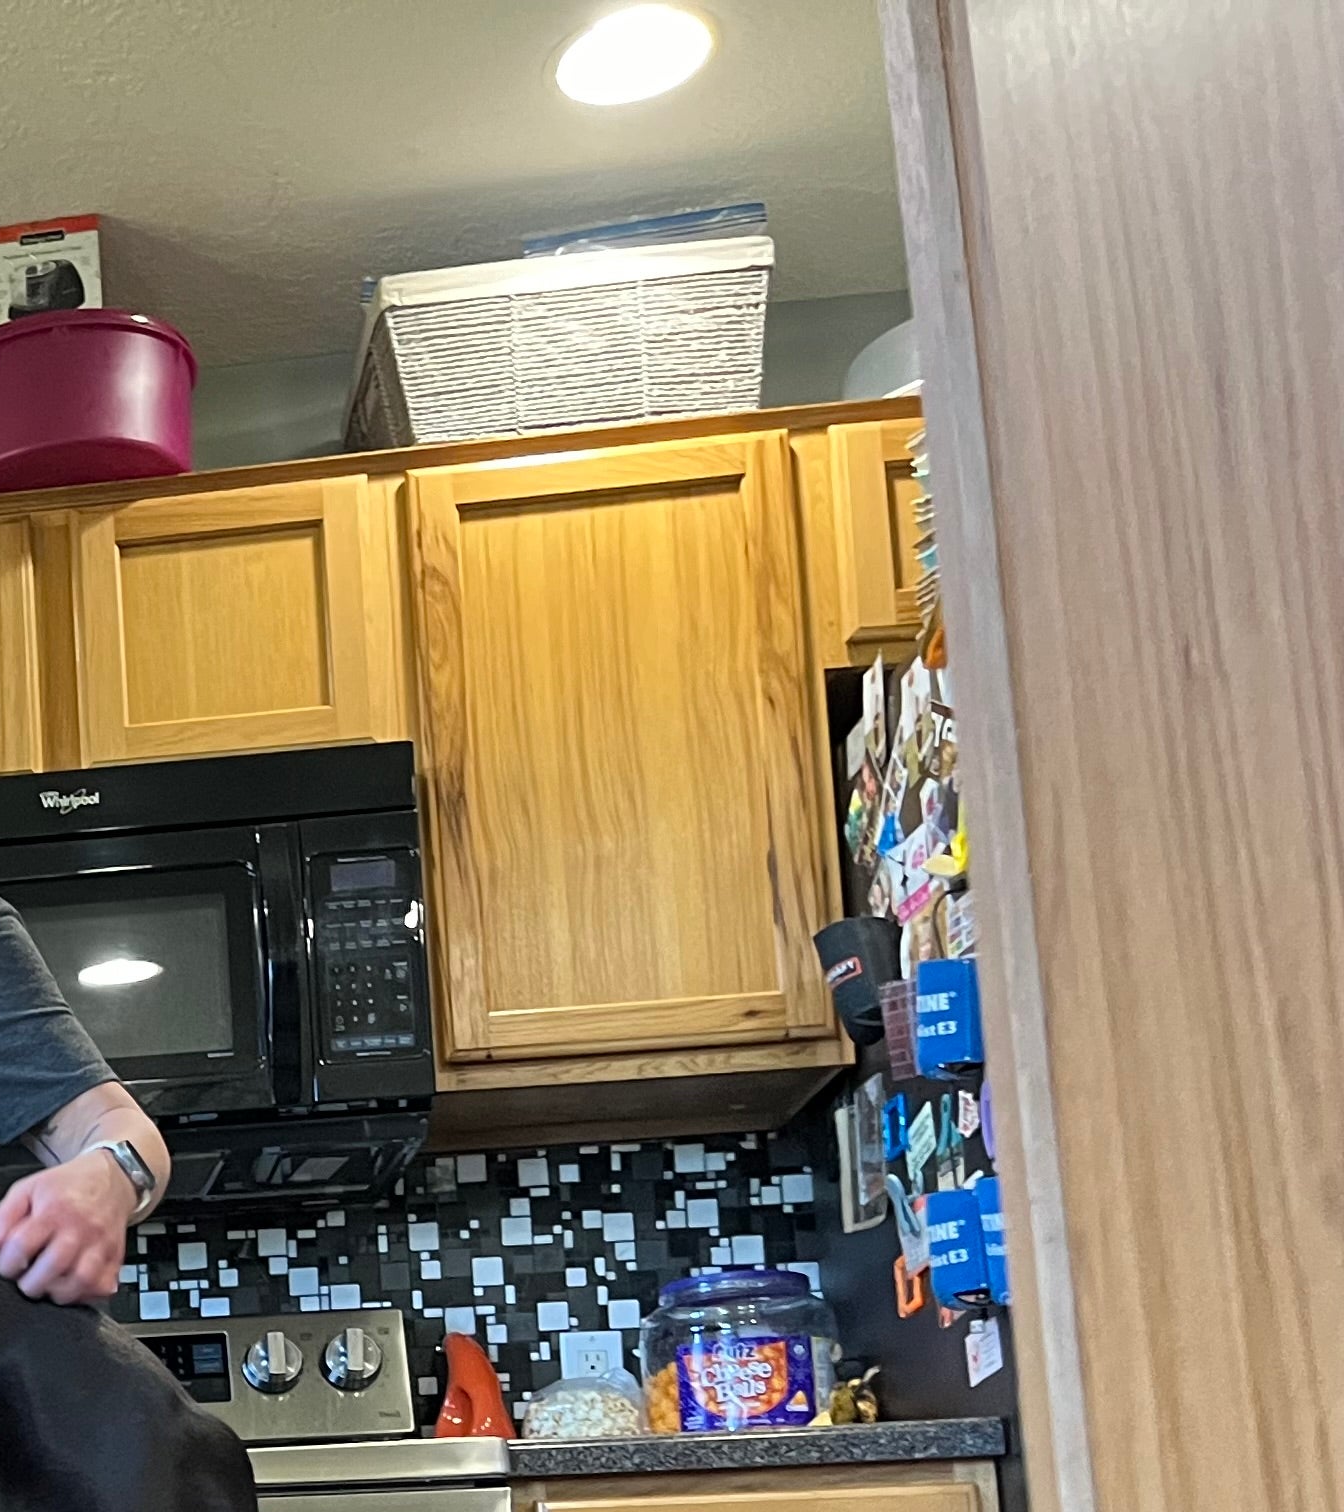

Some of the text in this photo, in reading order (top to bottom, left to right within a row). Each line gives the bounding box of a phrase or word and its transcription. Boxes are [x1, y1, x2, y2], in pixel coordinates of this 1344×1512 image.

[39, 790, 100, 813] Whirlpool
[937, 1020, 958, 1036] E3
[948, 1248, 969, 1264] E3
[701, 1360, 773, 1387] Cheese
